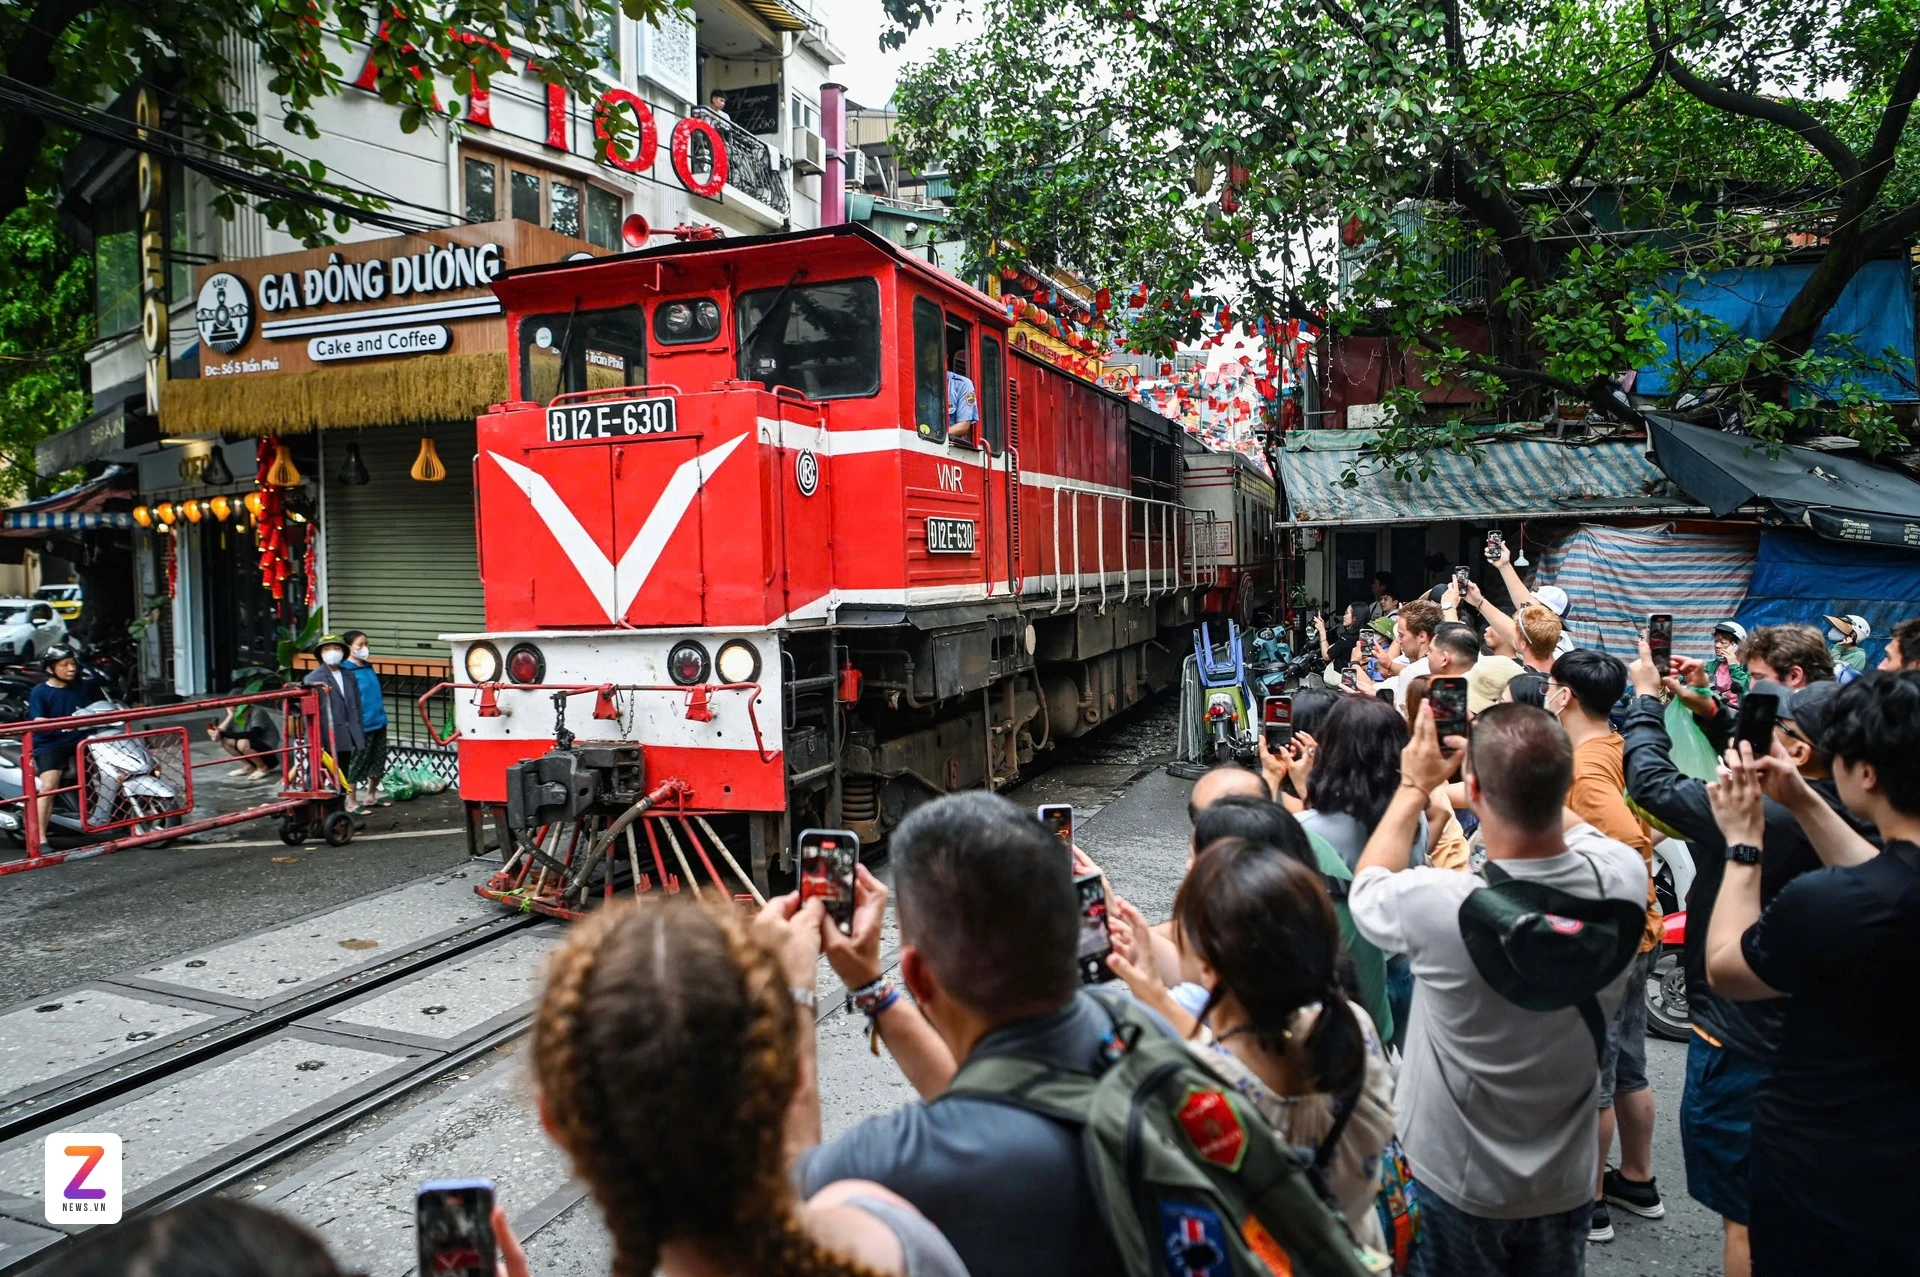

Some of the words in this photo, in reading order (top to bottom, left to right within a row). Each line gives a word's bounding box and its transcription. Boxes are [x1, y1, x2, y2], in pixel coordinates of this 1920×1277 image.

[258, 272, 299, 313] GA
[303, 252, 385, 307] ĐÔNG
[391, 241, 501, 295] DƯƠNG
[316, 339, 351, 357] Cake
[357, 335, 383, 353] and
[388, 329, 438, 350] Coffee
[235, 362, 241, 374] 5
[936, 462, 964, 493] VNR
